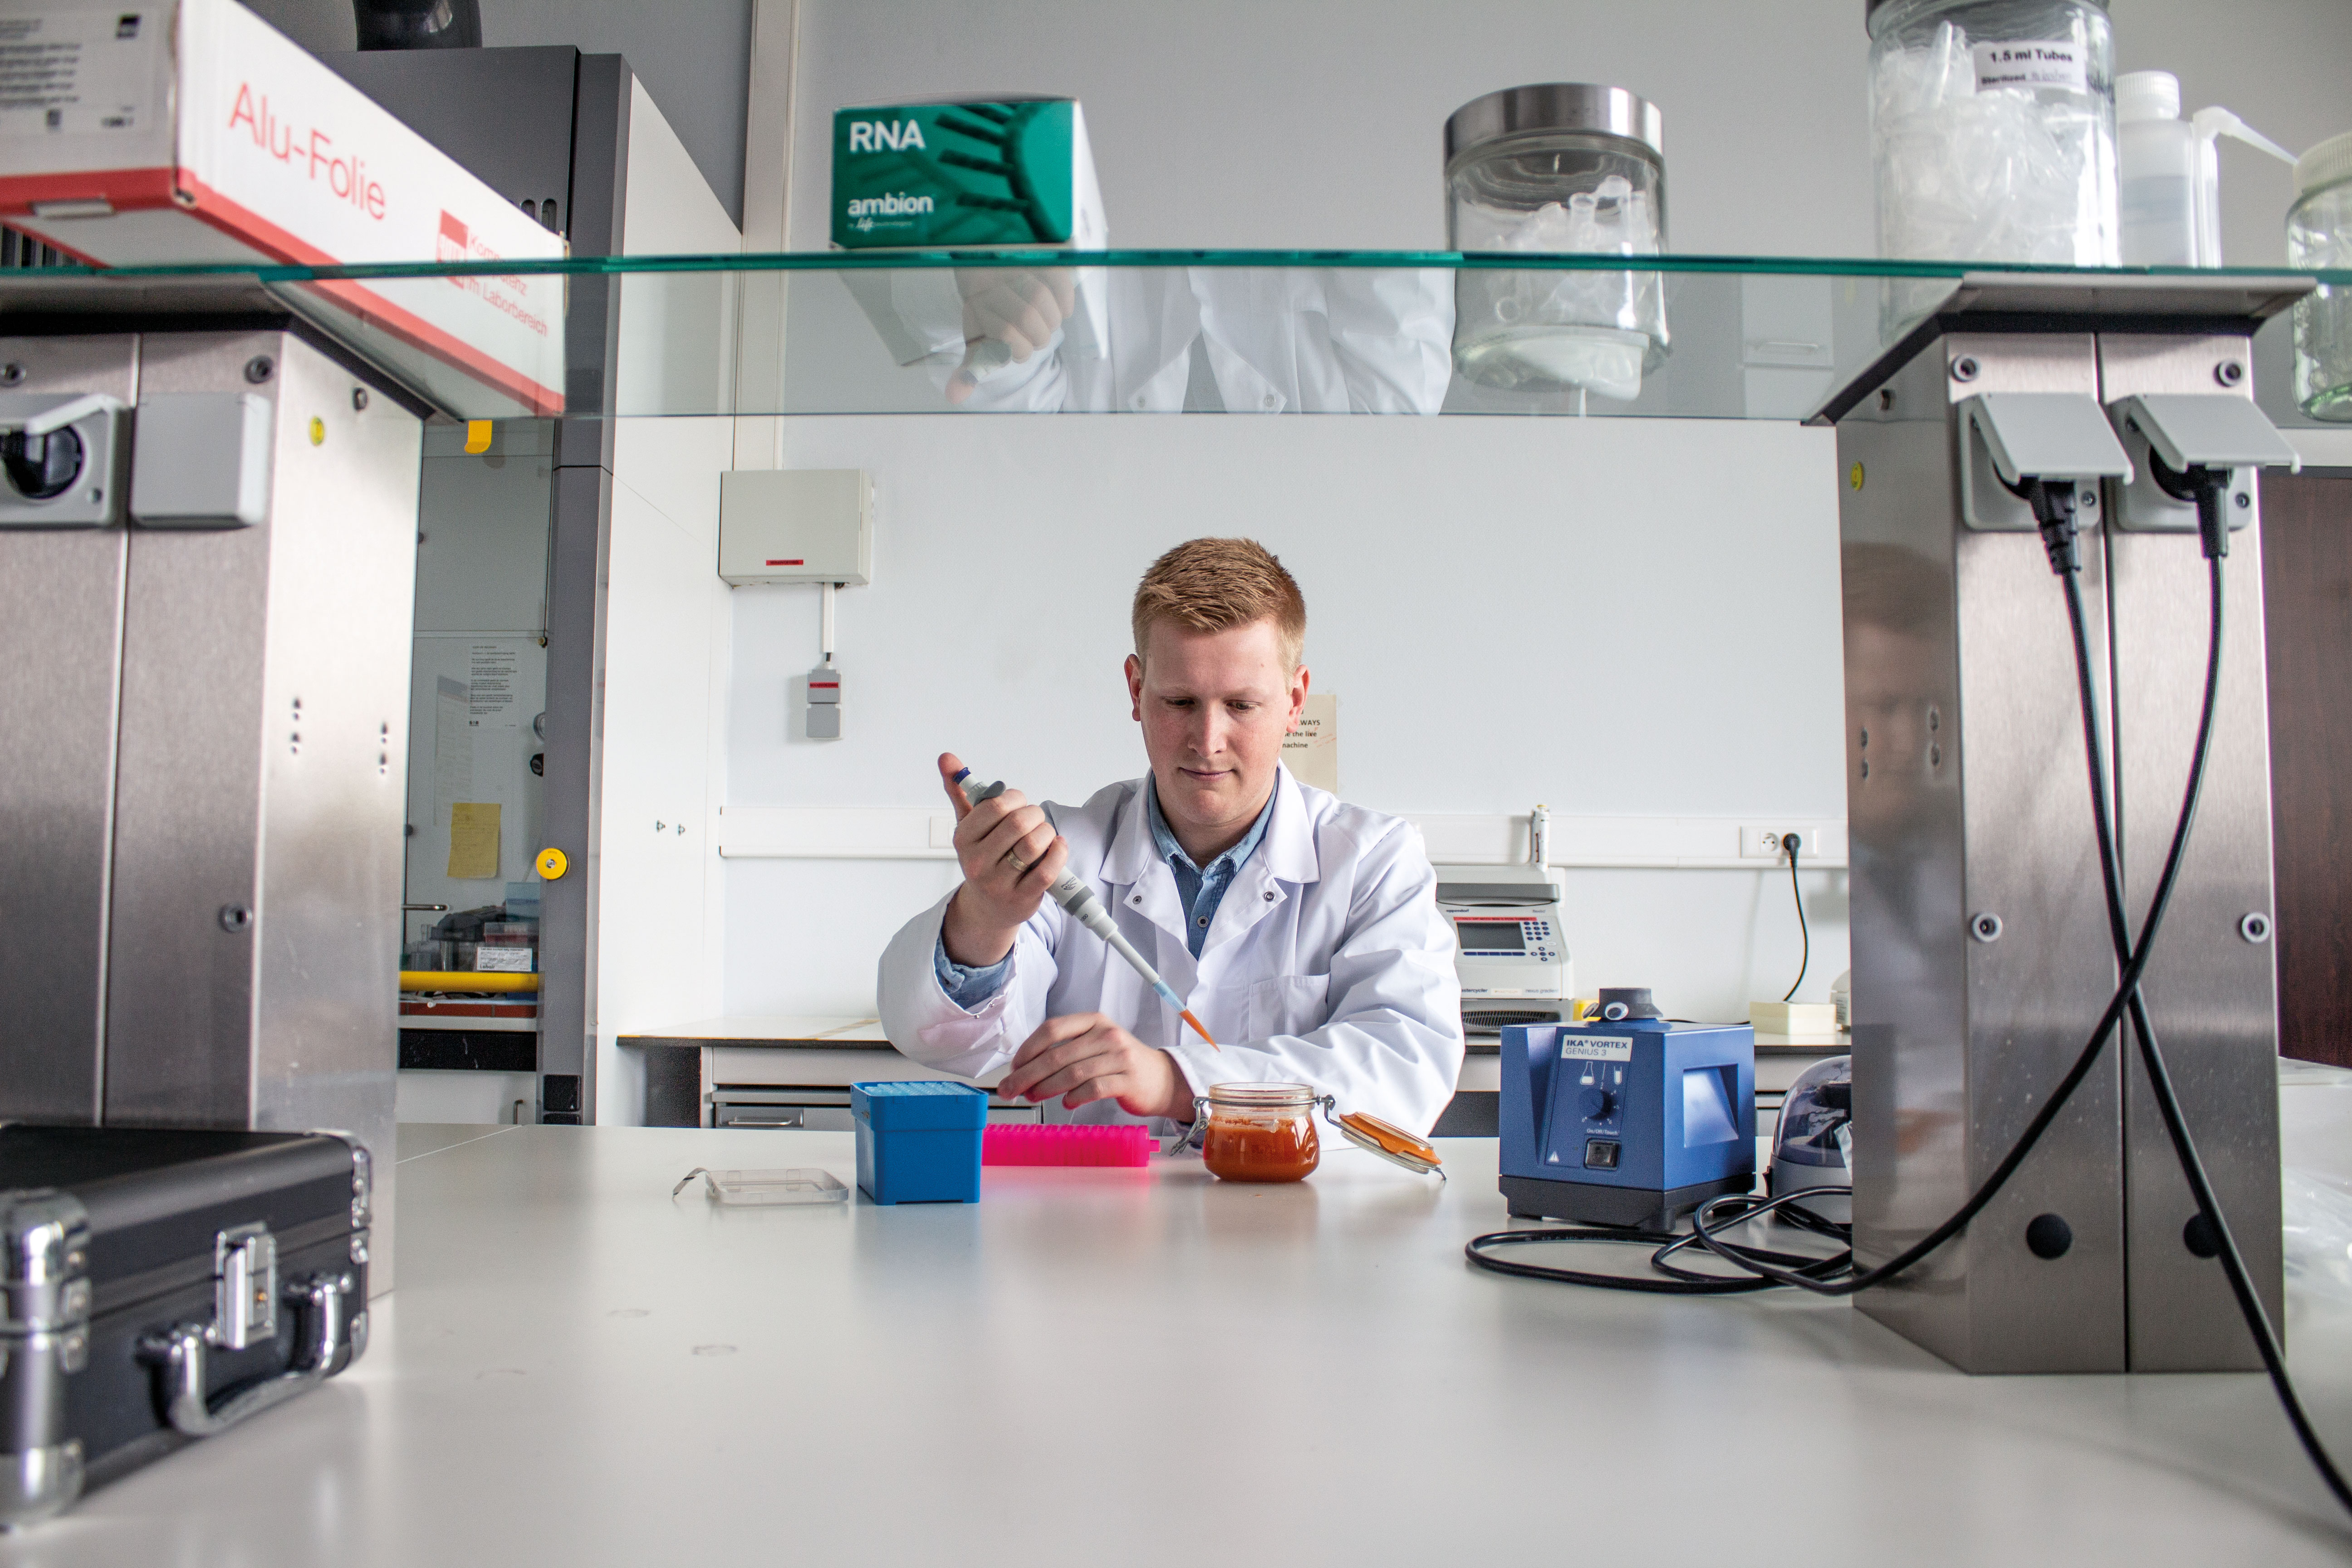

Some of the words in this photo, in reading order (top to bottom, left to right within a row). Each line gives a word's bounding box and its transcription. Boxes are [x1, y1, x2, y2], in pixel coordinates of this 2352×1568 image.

[1990, 49, 2011, 63] 1.5
[2015, 49, 2031, 60] ml
[2035, 48, 2073, 62] Tubes
[850, 118, 926, 152] RNA
[228, 82, 385, 220] Alu-Folie
[848, 191, 934, 217] ambion
[482, 281, 548, 337] Laborbereich
[1565, 1047, 1599, 1056] GENIUS
[1590, 1040, 1627, 1049] VORTEX
